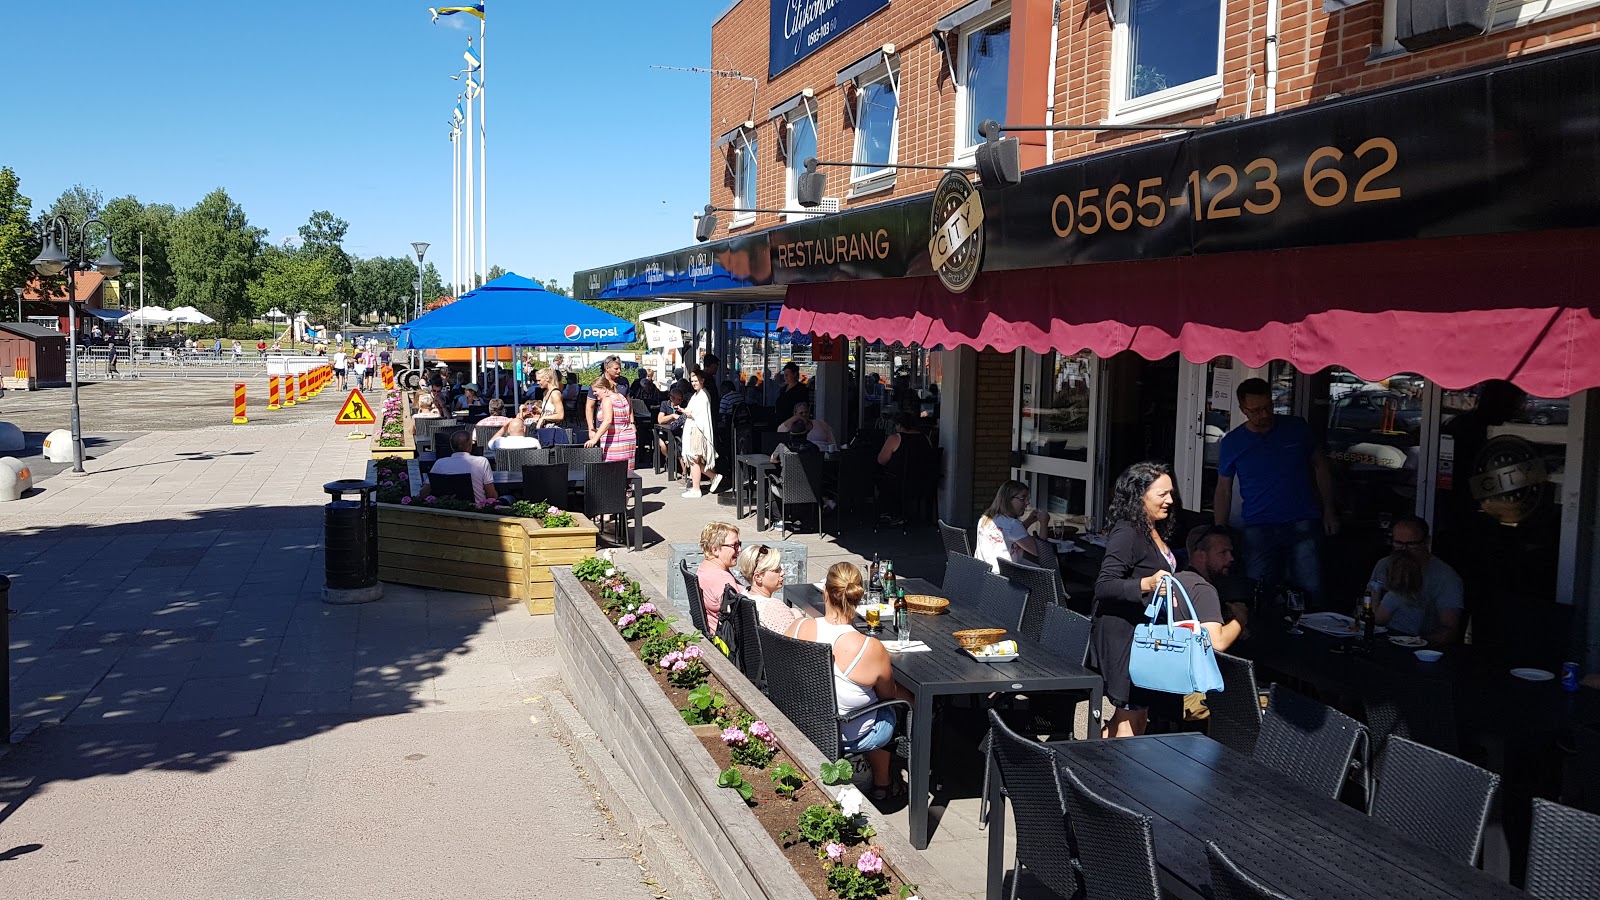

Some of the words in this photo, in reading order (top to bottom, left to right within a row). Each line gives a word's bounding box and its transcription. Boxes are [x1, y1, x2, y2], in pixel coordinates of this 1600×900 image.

[1051, 157, 1282, 238] 0565-123
[1303, 136, 1401, 207] 62
[778, 228, 890, 268] RESTAURANG
[937, 201, 971, 256] CITY
